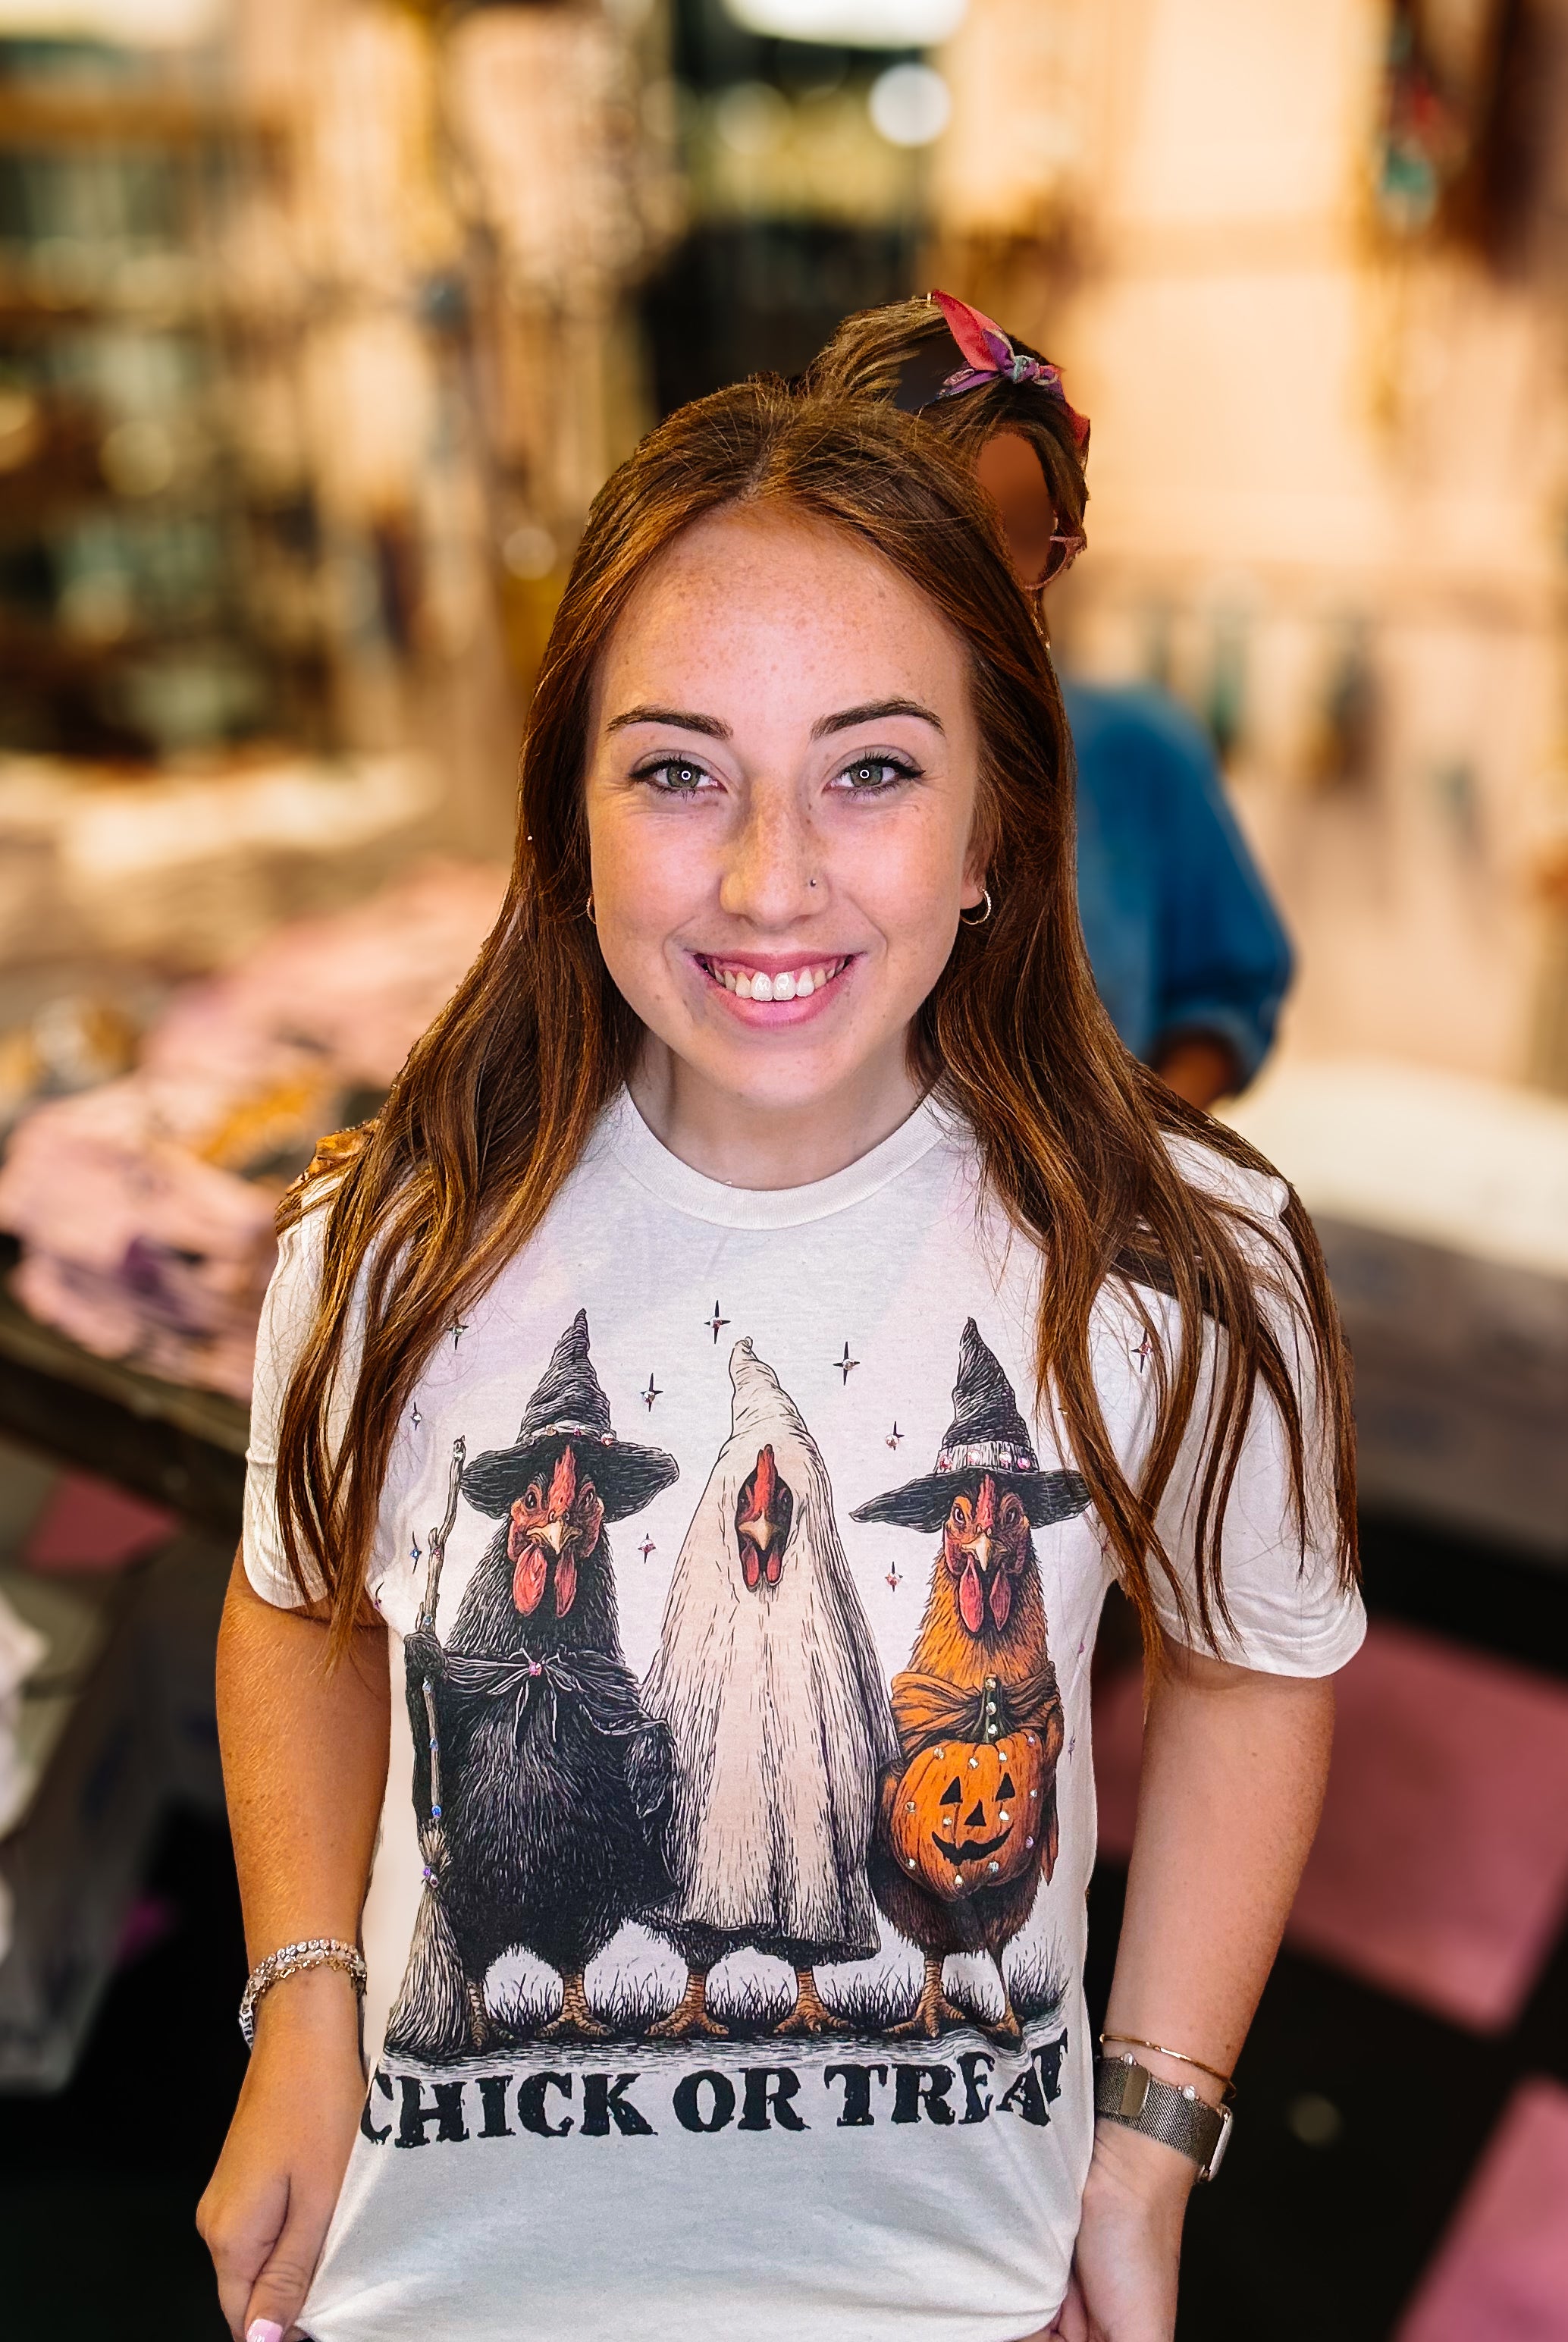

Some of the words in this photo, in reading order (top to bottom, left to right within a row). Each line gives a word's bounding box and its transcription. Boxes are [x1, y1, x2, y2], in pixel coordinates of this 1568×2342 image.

[360, 2071, 659, 2149] CHICK
[672, 2067, 812, 2133] OR
[823, 2026, 1068, 2127] TREAT
